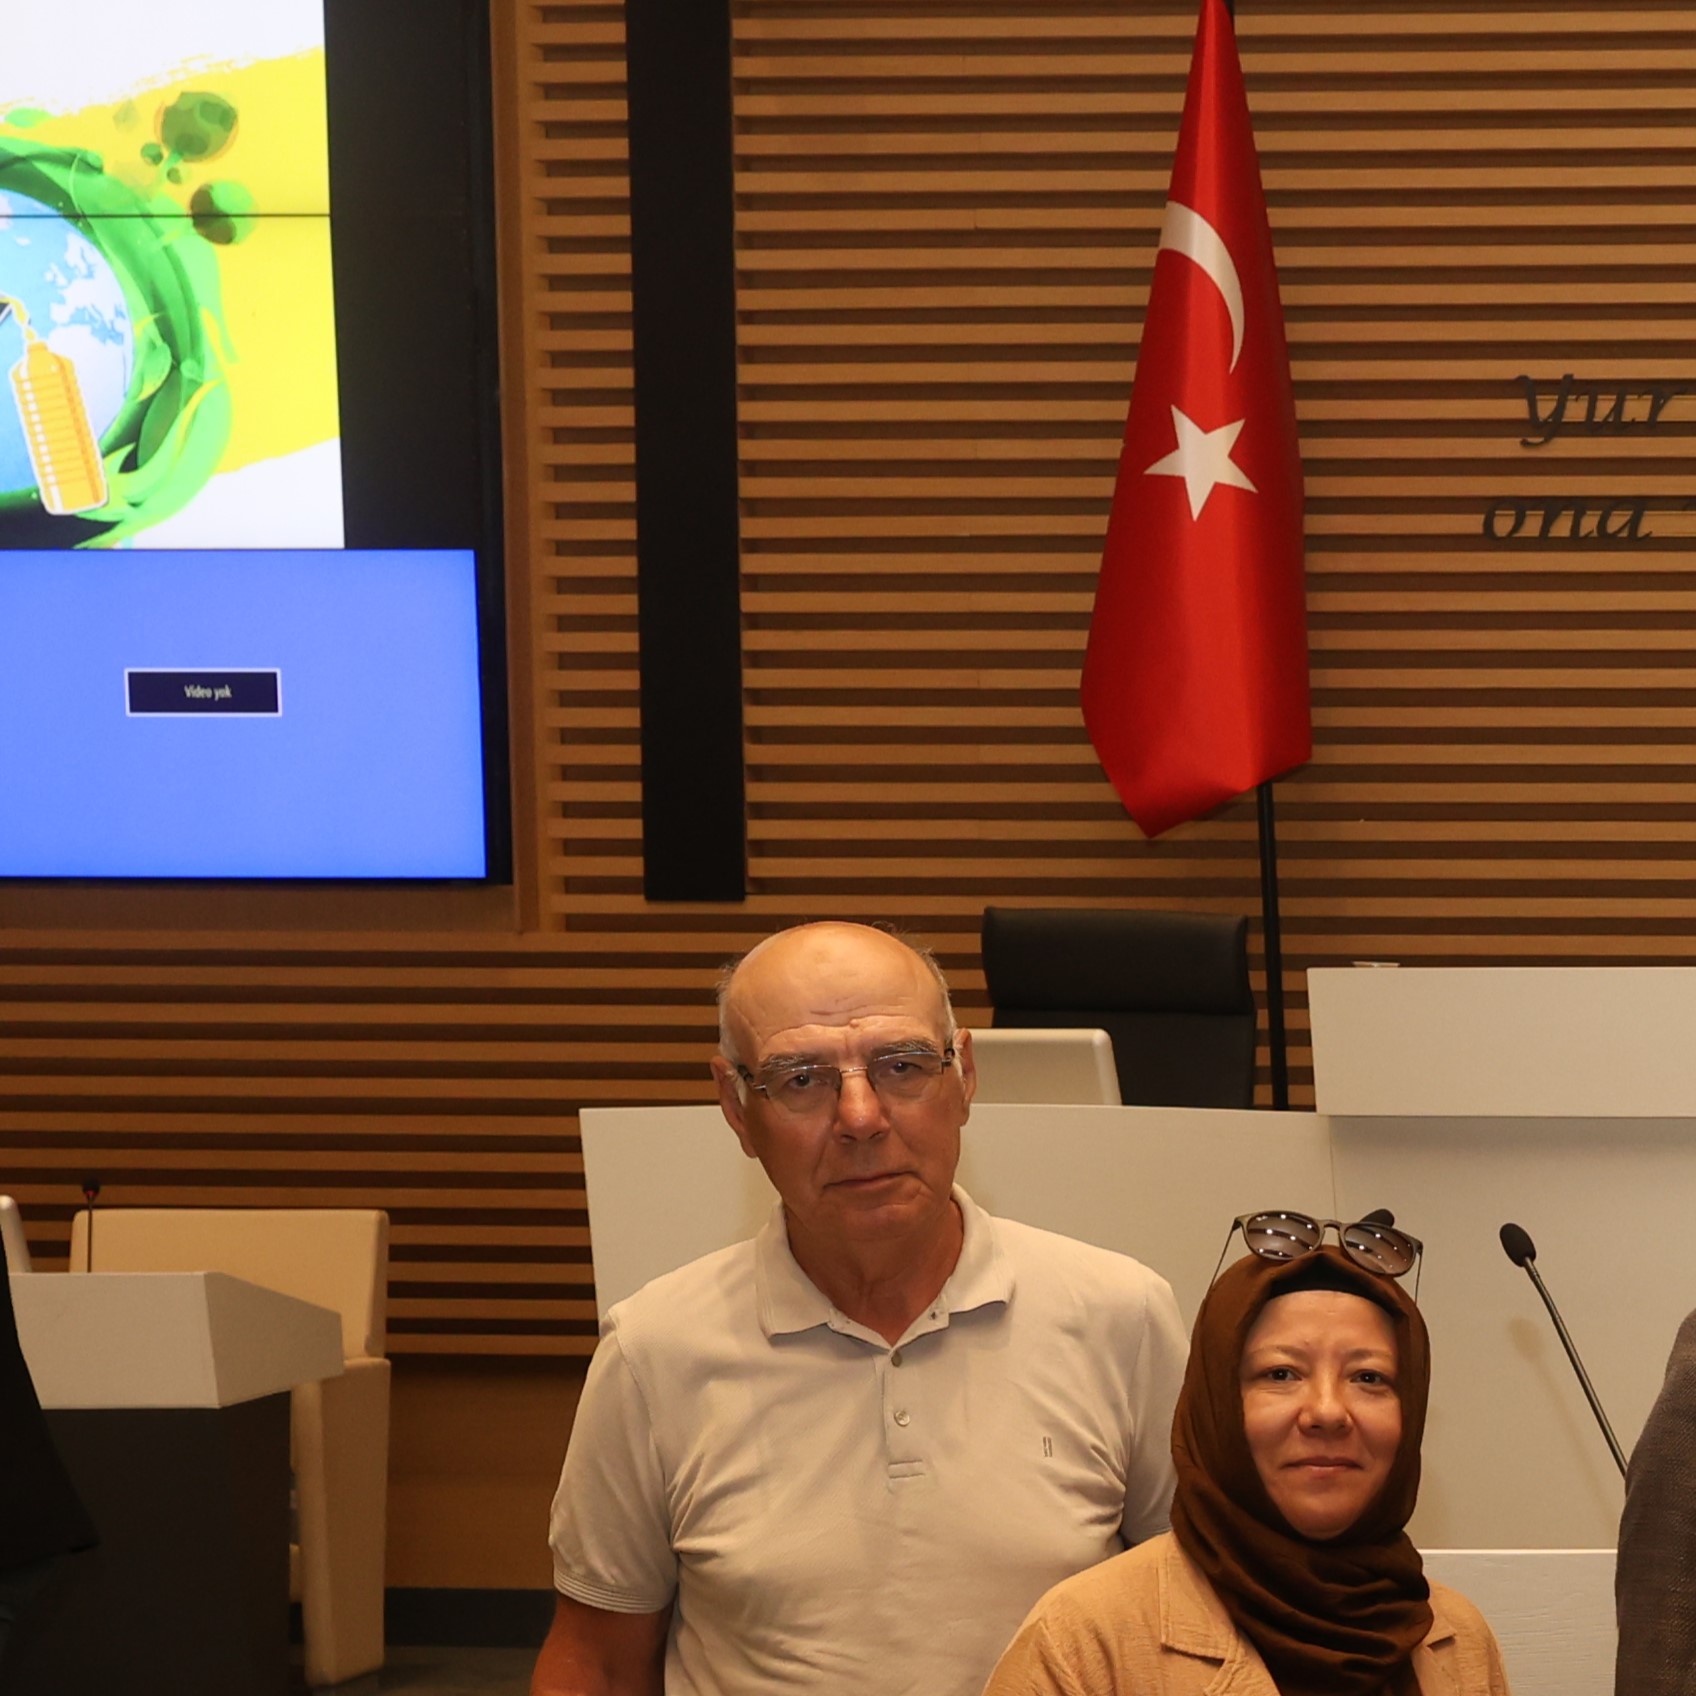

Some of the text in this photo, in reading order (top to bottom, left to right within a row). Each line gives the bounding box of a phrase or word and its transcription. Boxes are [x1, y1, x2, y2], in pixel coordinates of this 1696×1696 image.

[1481, 497, 1656, 542] ona
[184, 684, 232, 701] Video yok
